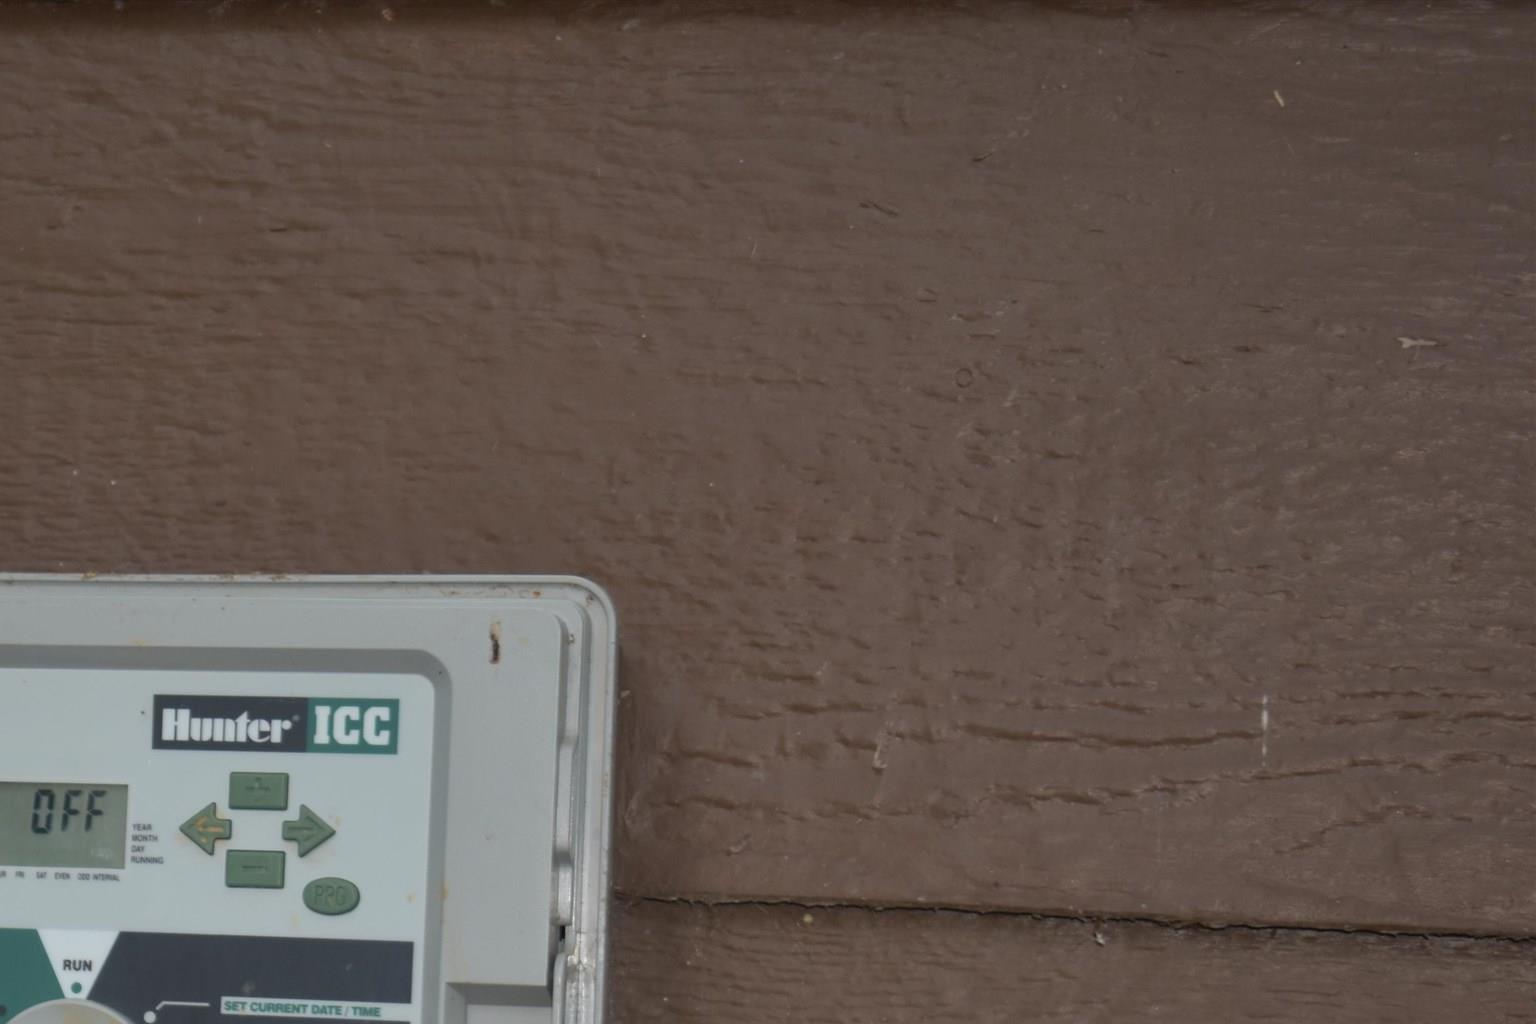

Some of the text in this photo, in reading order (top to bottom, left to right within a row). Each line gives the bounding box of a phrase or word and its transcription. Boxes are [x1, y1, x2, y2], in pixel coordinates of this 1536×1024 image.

[161, 705, 391, 746] Hunter ICC
[31, 788, 107, 835] OFF
[132, 823, 152, 832] YEAR
[131, 834, 158, 843] MONTH
[131, 845, 145, 854] DAY
[130, 856, 164, 865] RUNNING
[314, 885, 346, 906] PRG
[62, 959, 92, 972] RUN
[224, 1001, 247, 1011] SET
[250, 1001, 308, 1014] CURRENT
[311, 1004, 342, 1016] DATE
[351, 1006, 381, 1017] TIME
